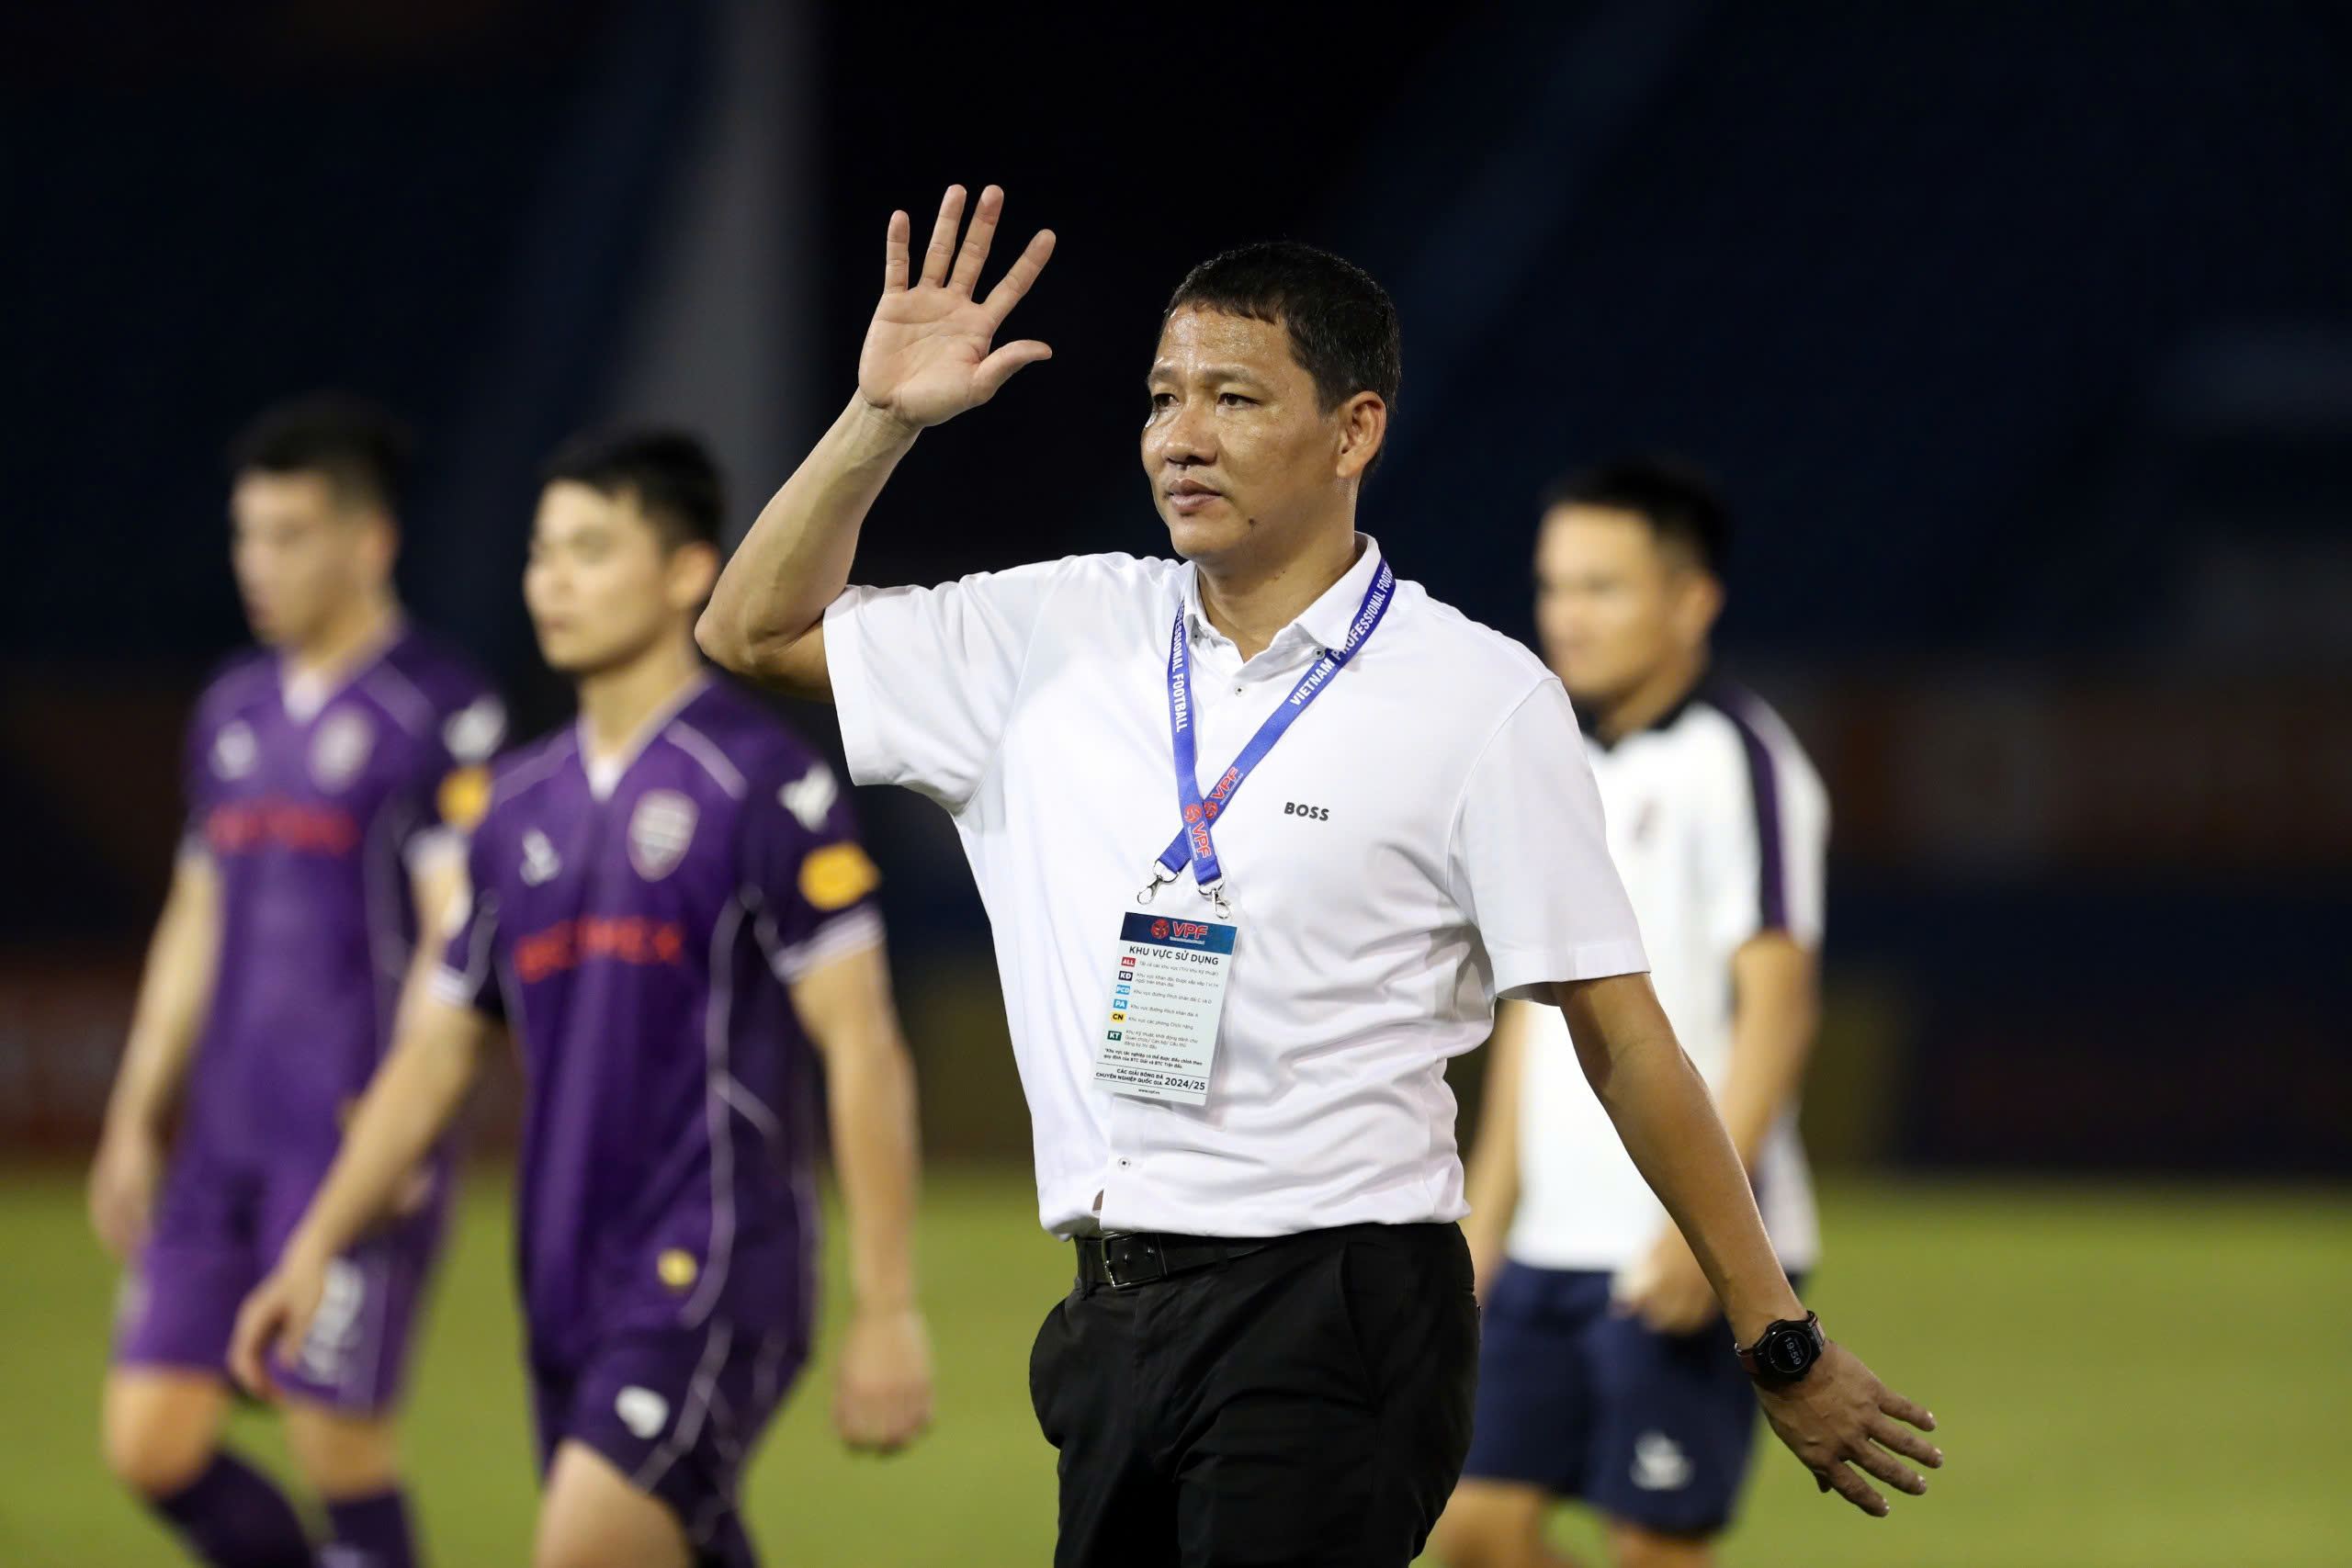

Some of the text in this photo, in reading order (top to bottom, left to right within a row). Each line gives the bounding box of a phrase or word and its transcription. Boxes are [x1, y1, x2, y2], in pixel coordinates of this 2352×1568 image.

[1289, 658, 1335, 705] VIETNAM
[1172, 673, 1187, 733] FOOTBALL
[1210, 767, 1238, 799] VPF
[1283, 801, 1329, 821] BOSS
[1193, 821, 1212, 858] VPF
[1172, 920, 1208, 939] VPF
[1129, 945, 1219, 967] KHU VỰC SỬ DỤNG
[1164, 1076, 1205, 1091] 2024/25
